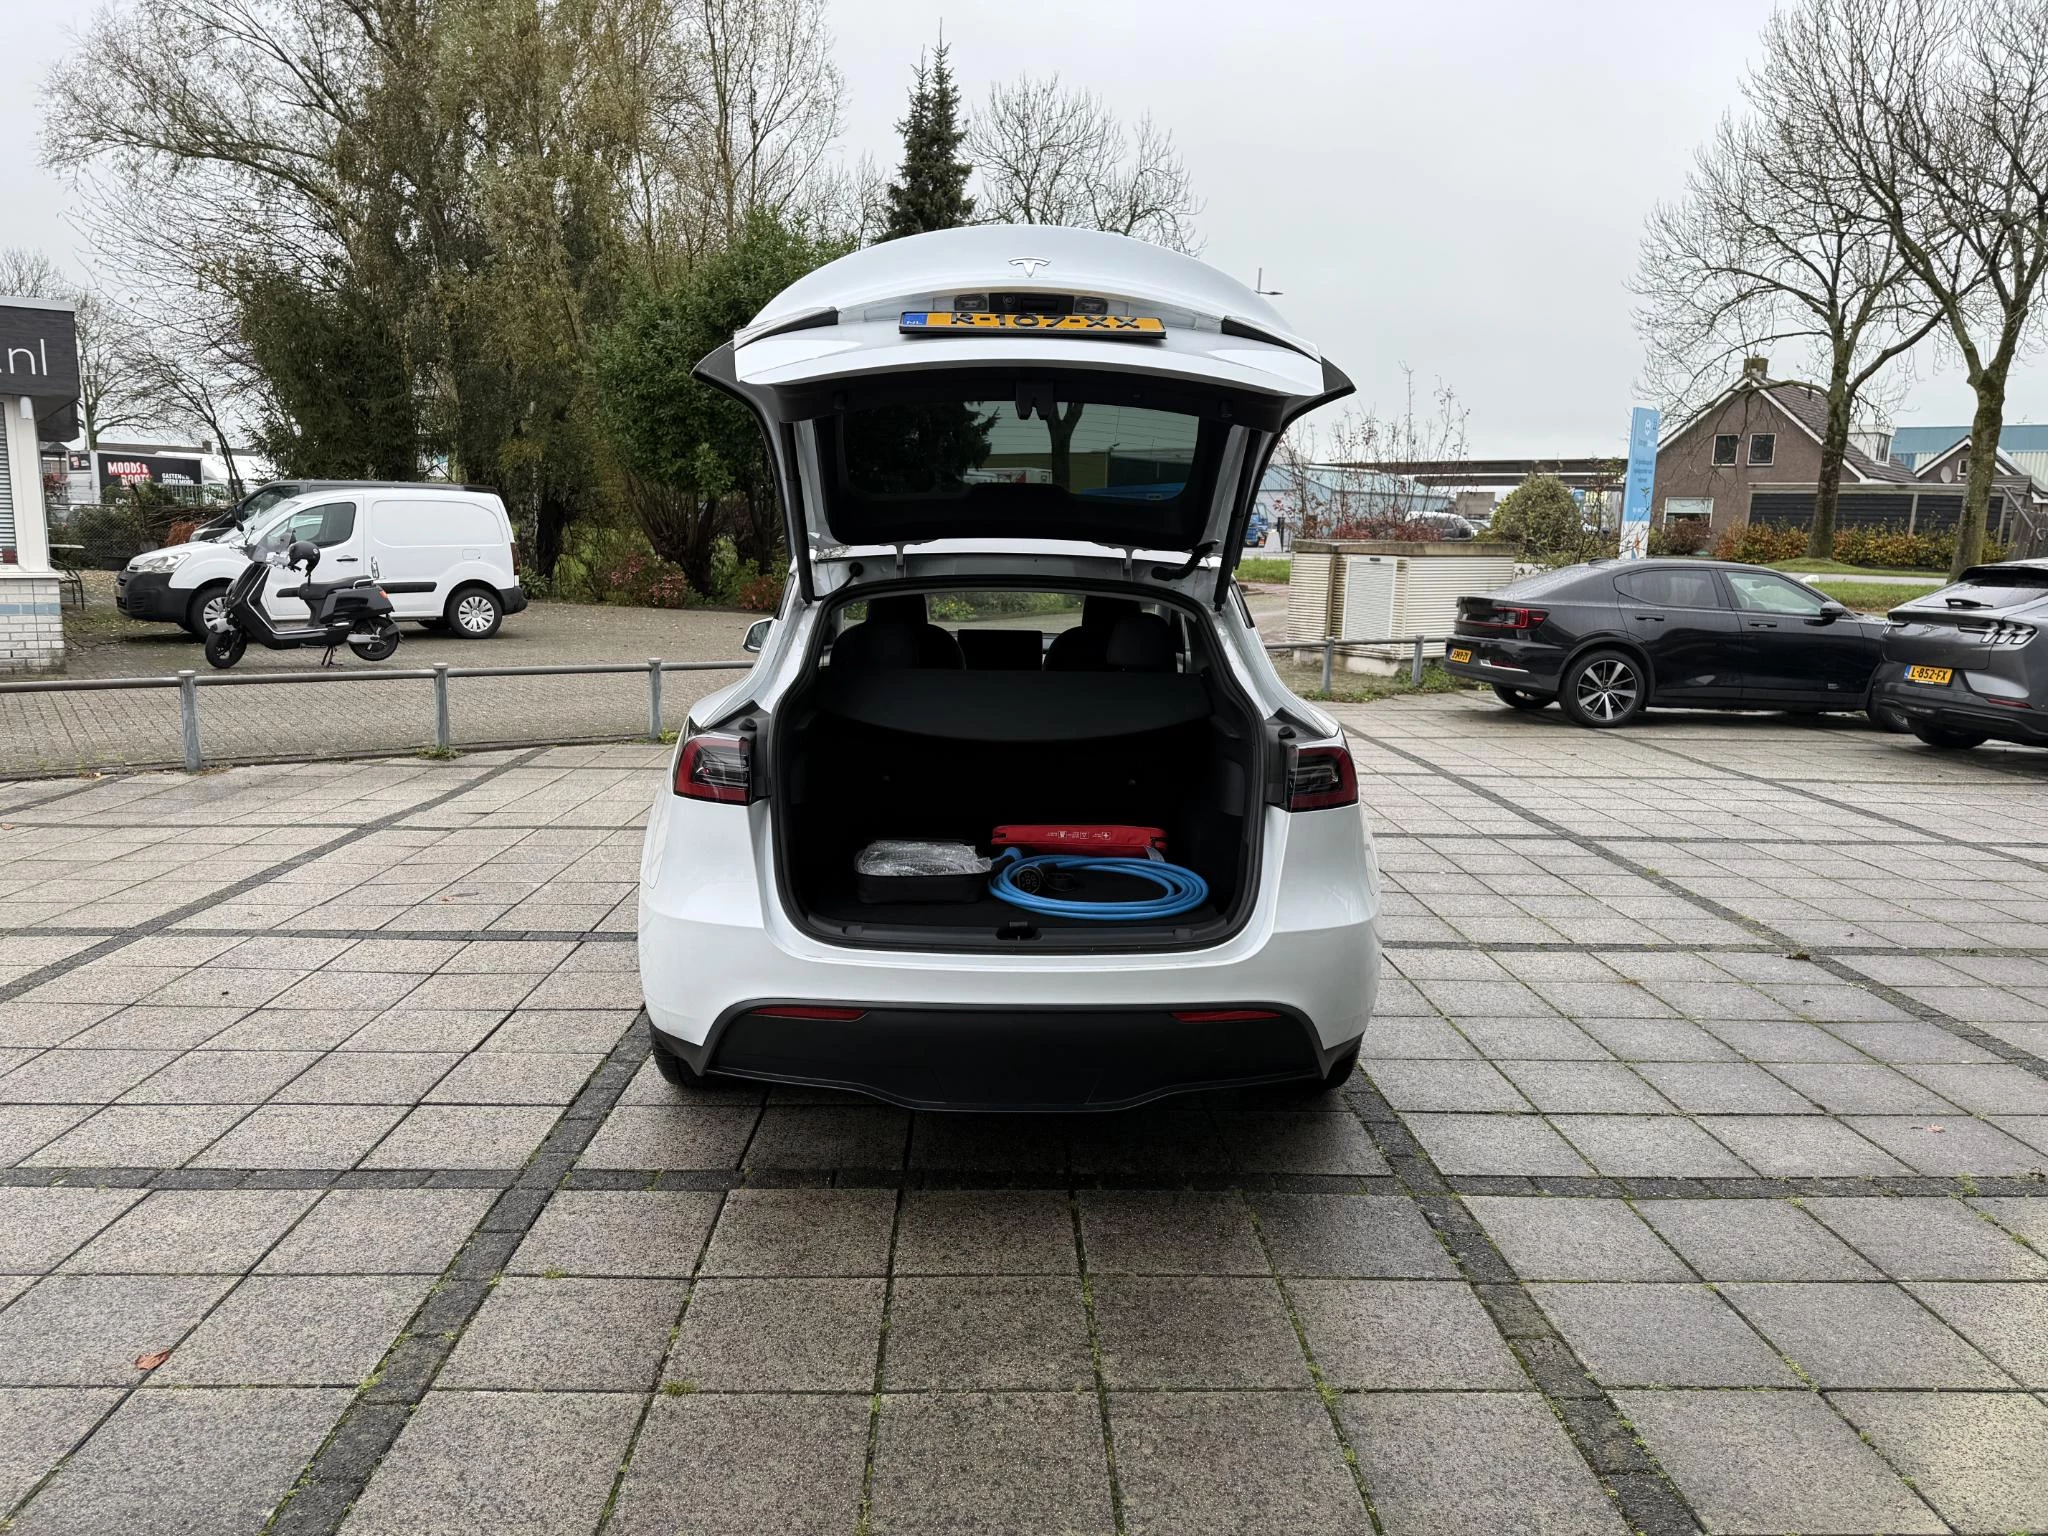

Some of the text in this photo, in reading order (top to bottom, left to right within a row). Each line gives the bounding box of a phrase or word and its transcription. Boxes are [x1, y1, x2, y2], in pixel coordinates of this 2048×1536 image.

[950, 312, 1140, 329] R-107-XX
[107, 461, 149, 474] MOODS &
[1911, 667, 1948, 681] L-852-FX
